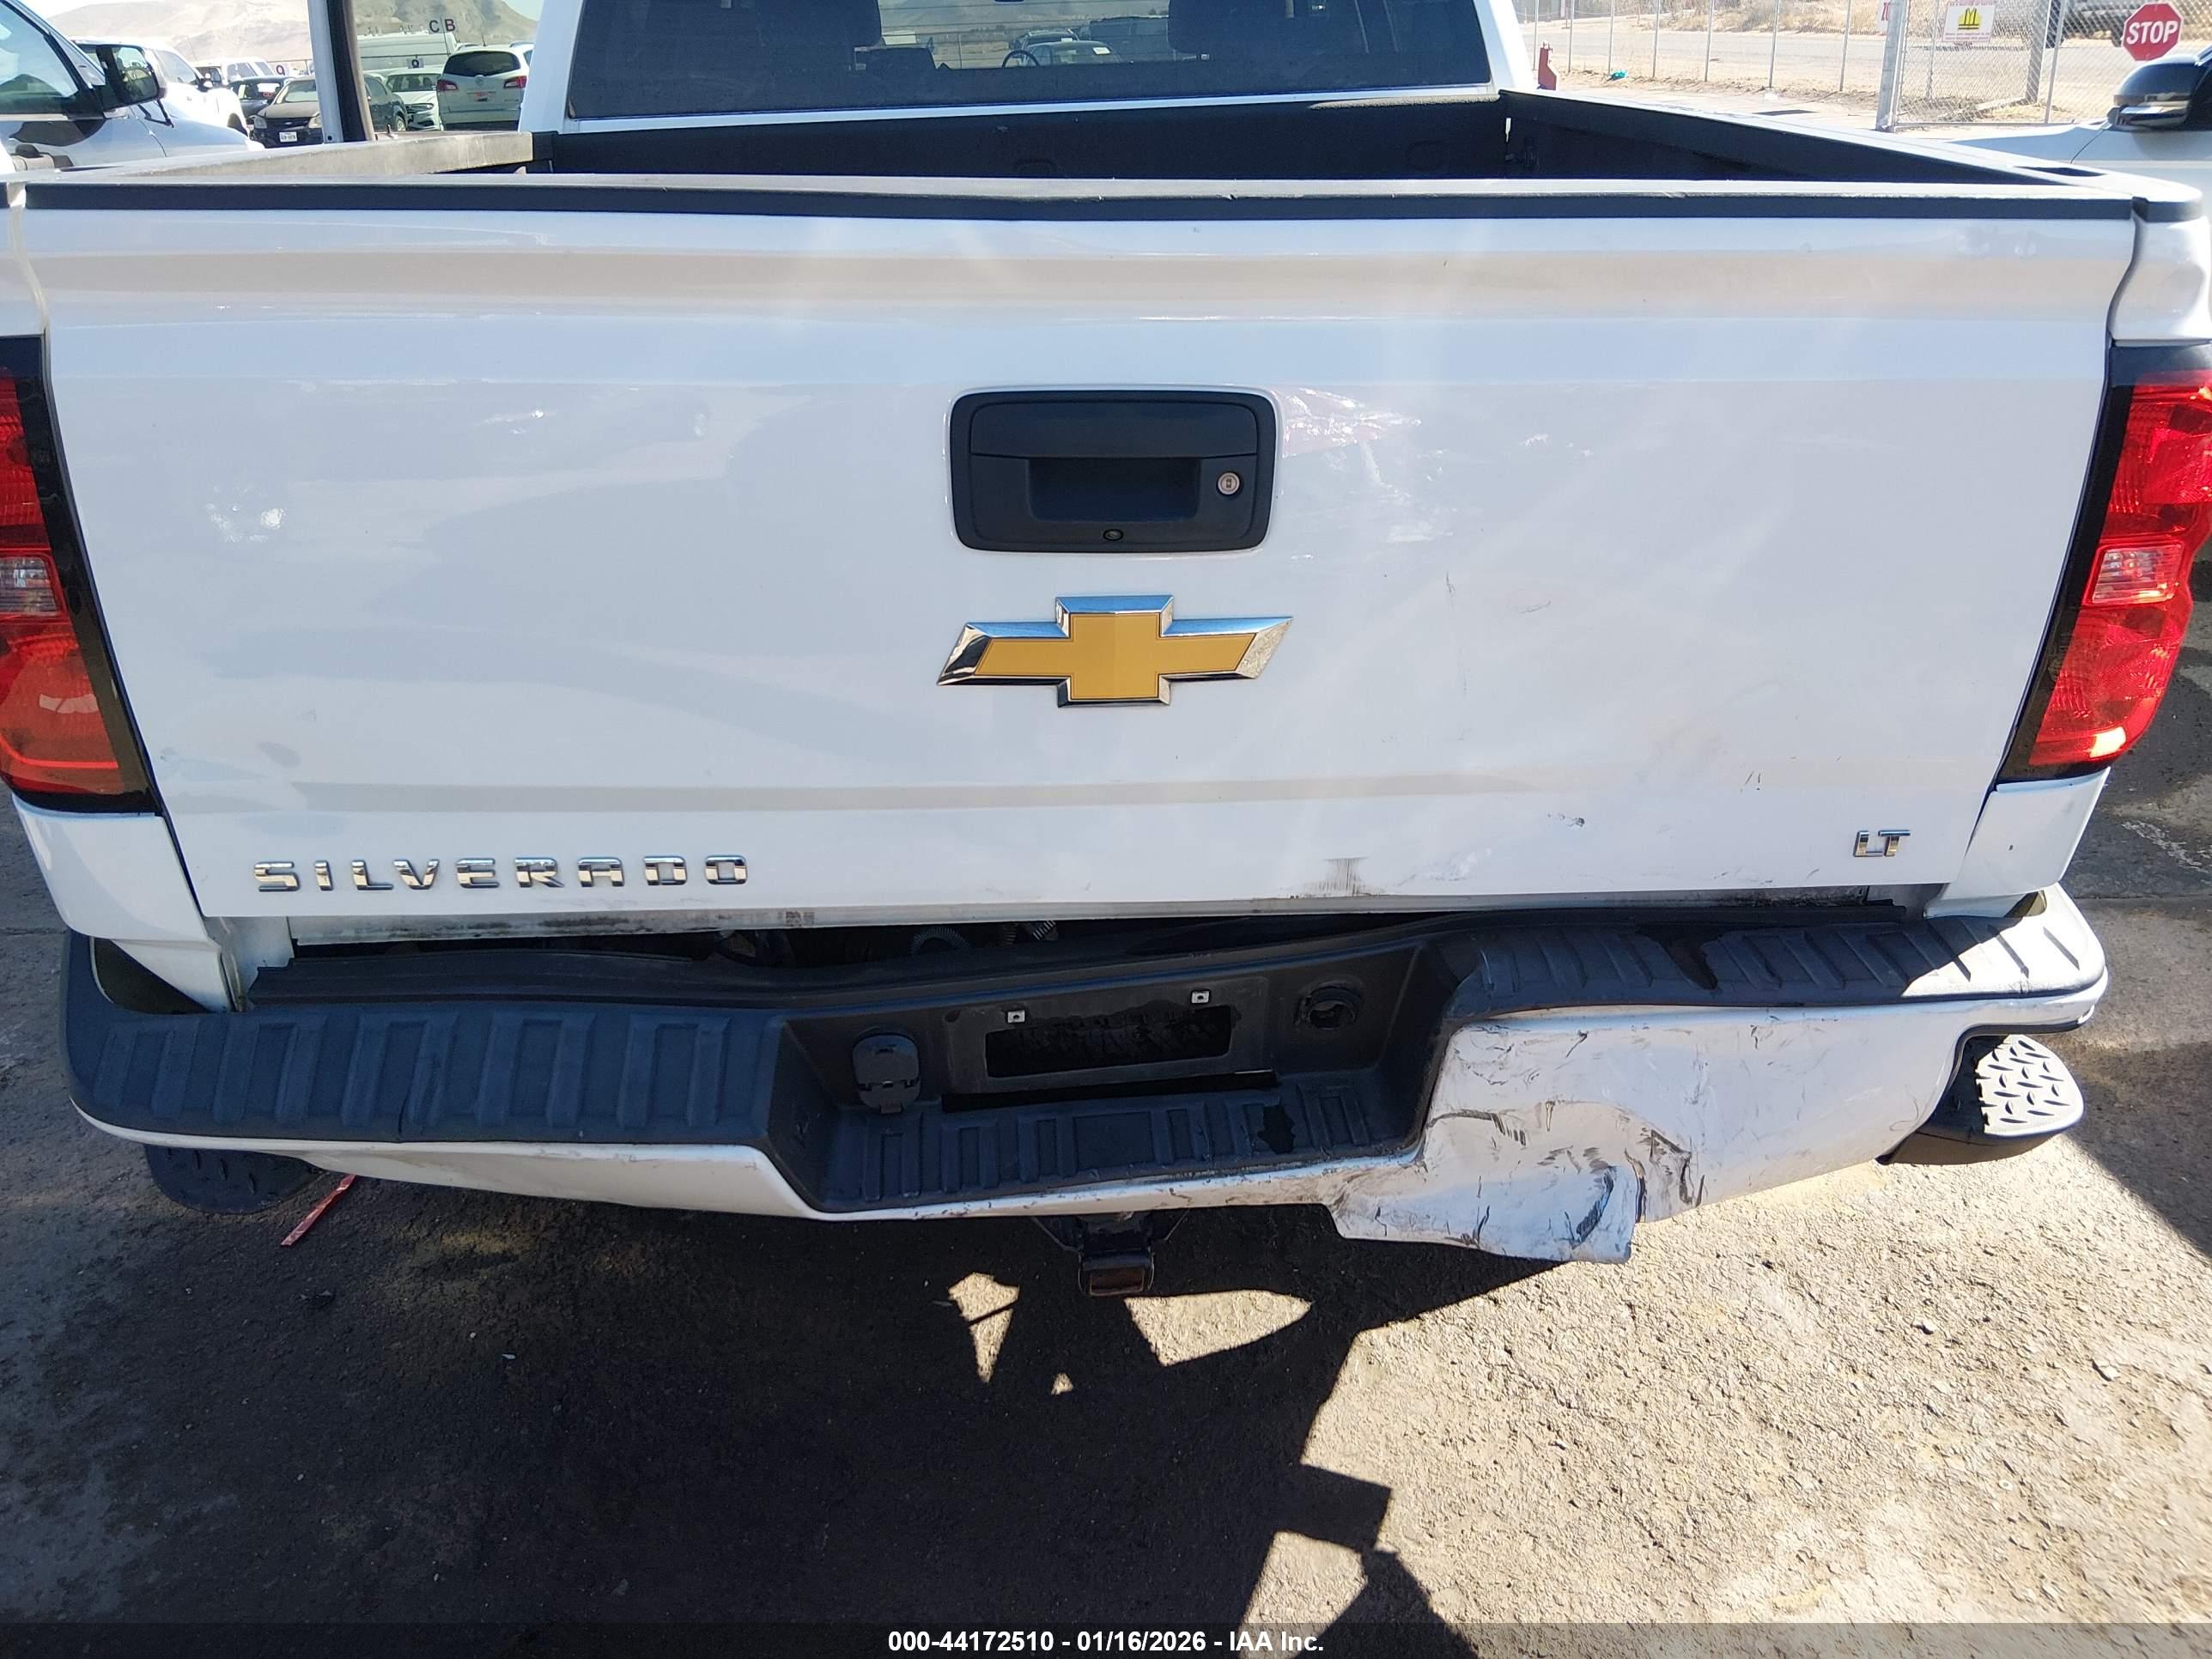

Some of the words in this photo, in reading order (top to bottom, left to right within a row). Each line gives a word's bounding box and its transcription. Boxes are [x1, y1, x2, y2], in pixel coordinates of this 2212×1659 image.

[429, 20, 440, 33] C
[444, 18, 455, 31] B
[2126, 20, 2179, 45] STOP
[1852, 830, 1911, 857] LT
[253, 854, 748, 892] SILVERADO
